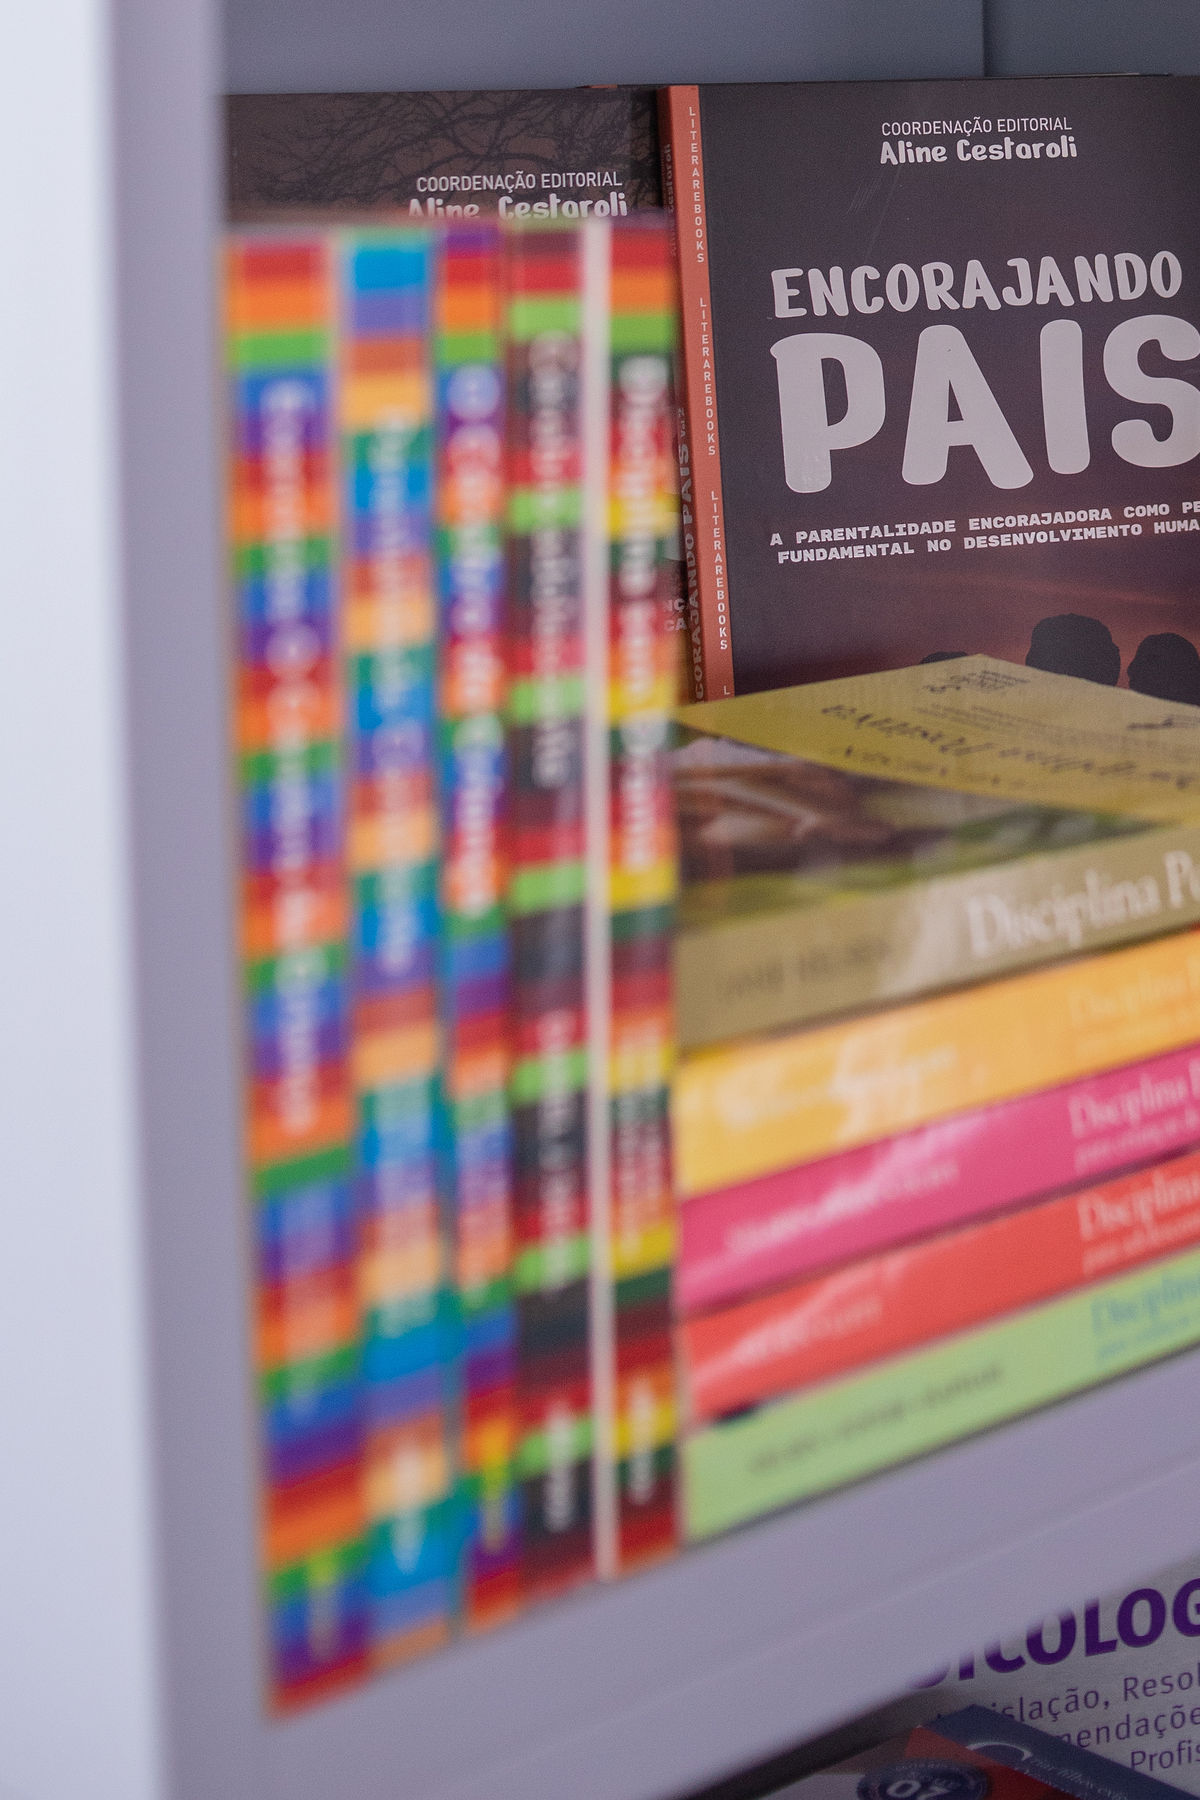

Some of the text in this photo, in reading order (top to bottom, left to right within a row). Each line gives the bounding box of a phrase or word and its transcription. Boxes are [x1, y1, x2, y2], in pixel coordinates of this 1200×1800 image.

[881, 116, 1073, 137] COORDENAÇÃO EDITORIAL
[880, 135, 1078, 166] Aline Cestaroli
[416, 171, 623, 193] COORDENAÇÃO EDITORIAL
[689, 106, 705, 263] LITERAREBOOKS
[408, 191, 628, 220] Aline Cestaroli
[770, 251, 1183, 319] ENCORAJANDO
[700, 297, 716, 456] LITERAREBOOKS
[769, 532, 784, 547] A
[795, 519, 957, 544] PARENTALIDADE
[968, 507, 1113, 531] ENCORAJADORA
[1123, 503, 1171, 519] COMO
[777, 540, 915, 565] FUNDAMENTAL
[926, 538, 952, 553] NO
[963, 523, 1143, 550] DESENVOLVIMENTO
[711, 490, 728, 650] LITERAREBOOKS
[966, 868, 1163, 960] Disciplina
[1068, 1073, 1188, 1141] Disciplina
[992, 1687, 1110, 1722] slação,
